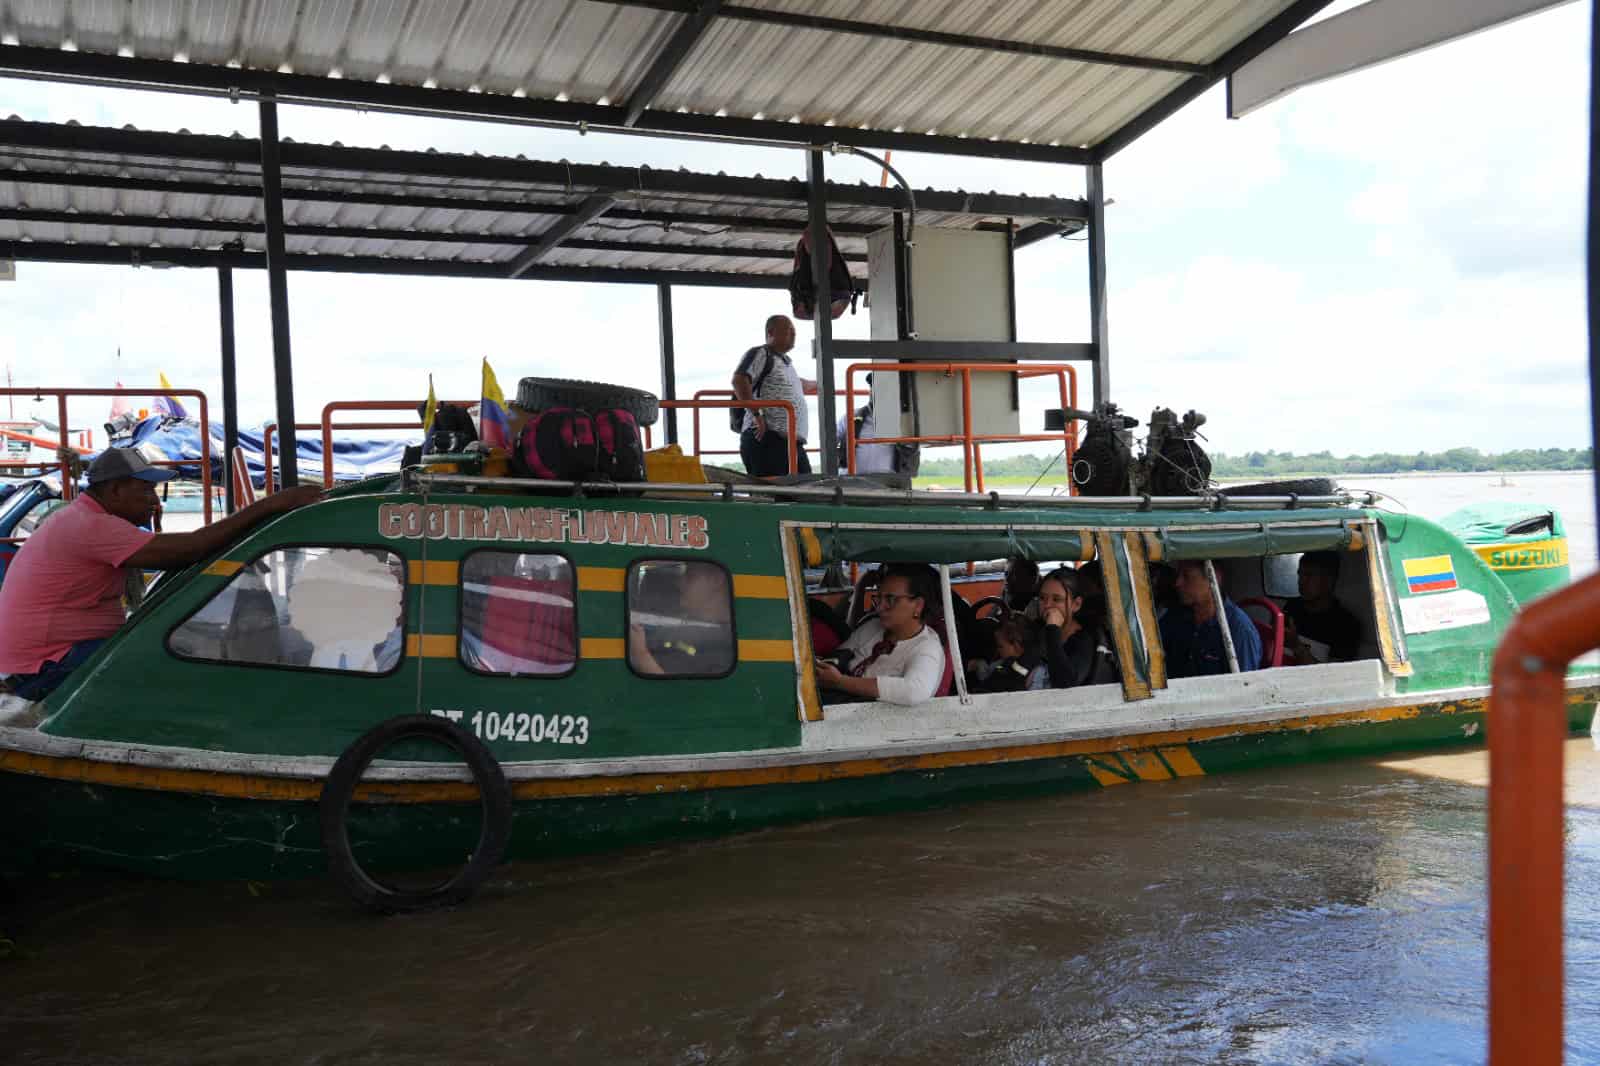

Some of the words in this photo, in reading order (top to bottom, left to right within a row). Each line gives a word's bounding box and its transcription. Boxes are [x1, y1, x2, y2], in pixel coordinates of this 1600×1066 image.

[378, 502, 710, 550] COOTRANSFLUVIALES
[1490, 546, 1560, 567] SUZUKI
[471, 710, 589, 745] 10420423
